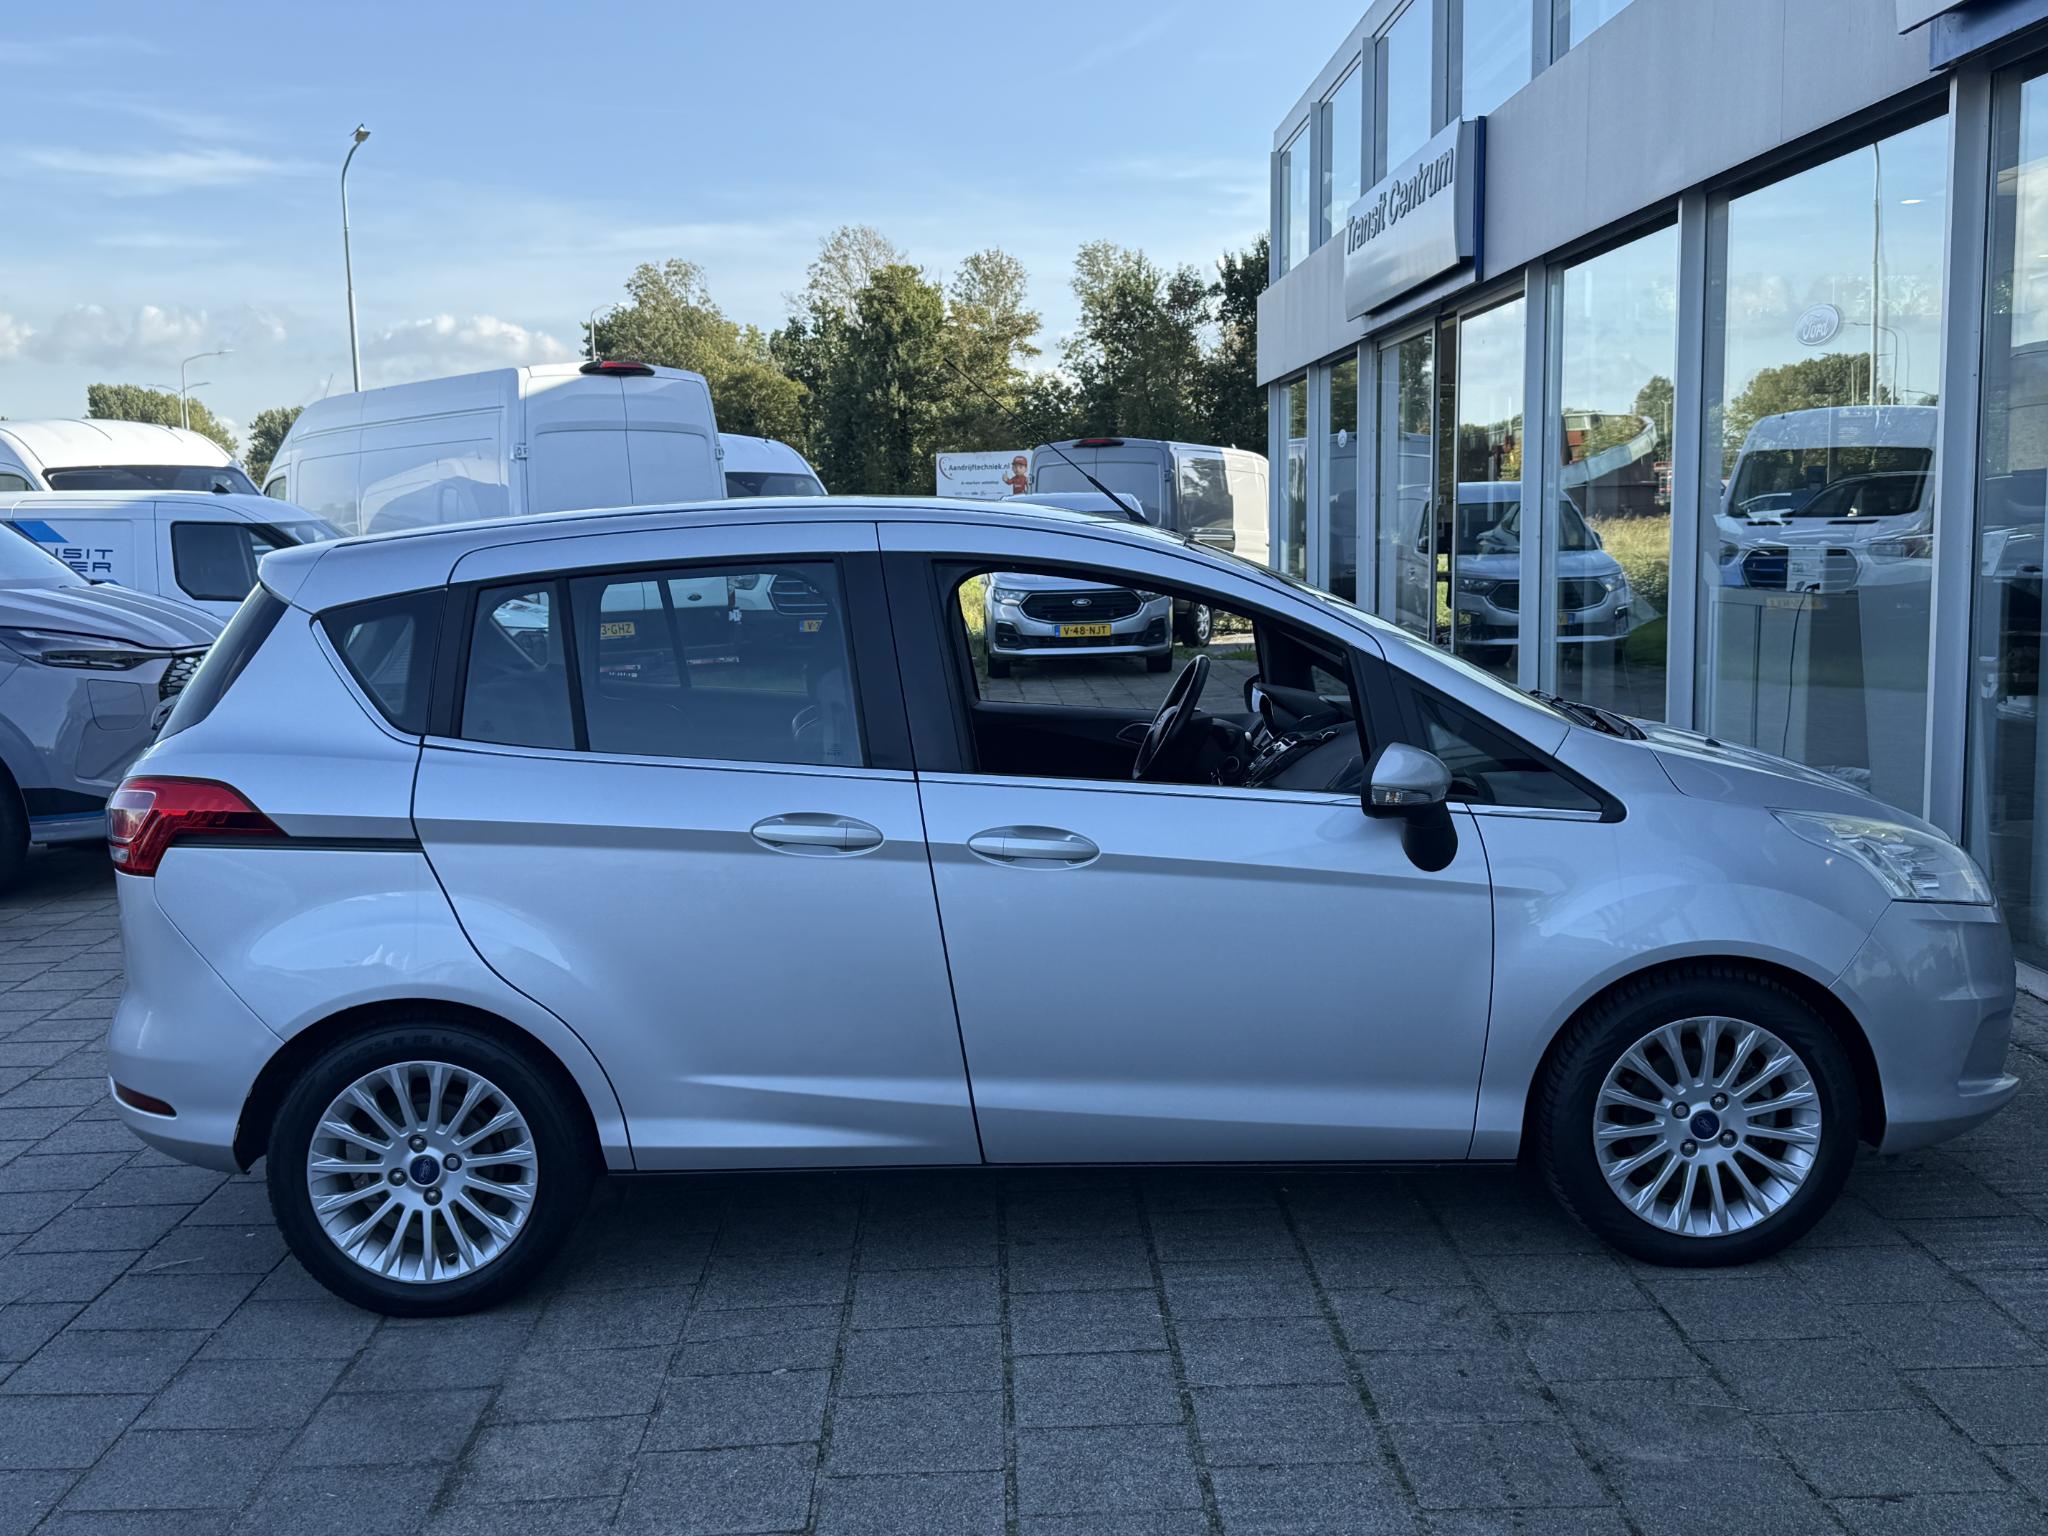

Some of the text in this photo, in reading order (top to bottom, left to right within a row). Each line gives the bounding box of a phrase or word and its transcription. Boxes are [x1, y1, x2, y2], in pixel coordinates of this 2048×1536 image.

[1347, 147, 1454, 255] Transit Centrum
[948, 463, 1011, 472] Aandrijftechniek.nl
[1063, 625, 1107, 636] V-48-NJT
